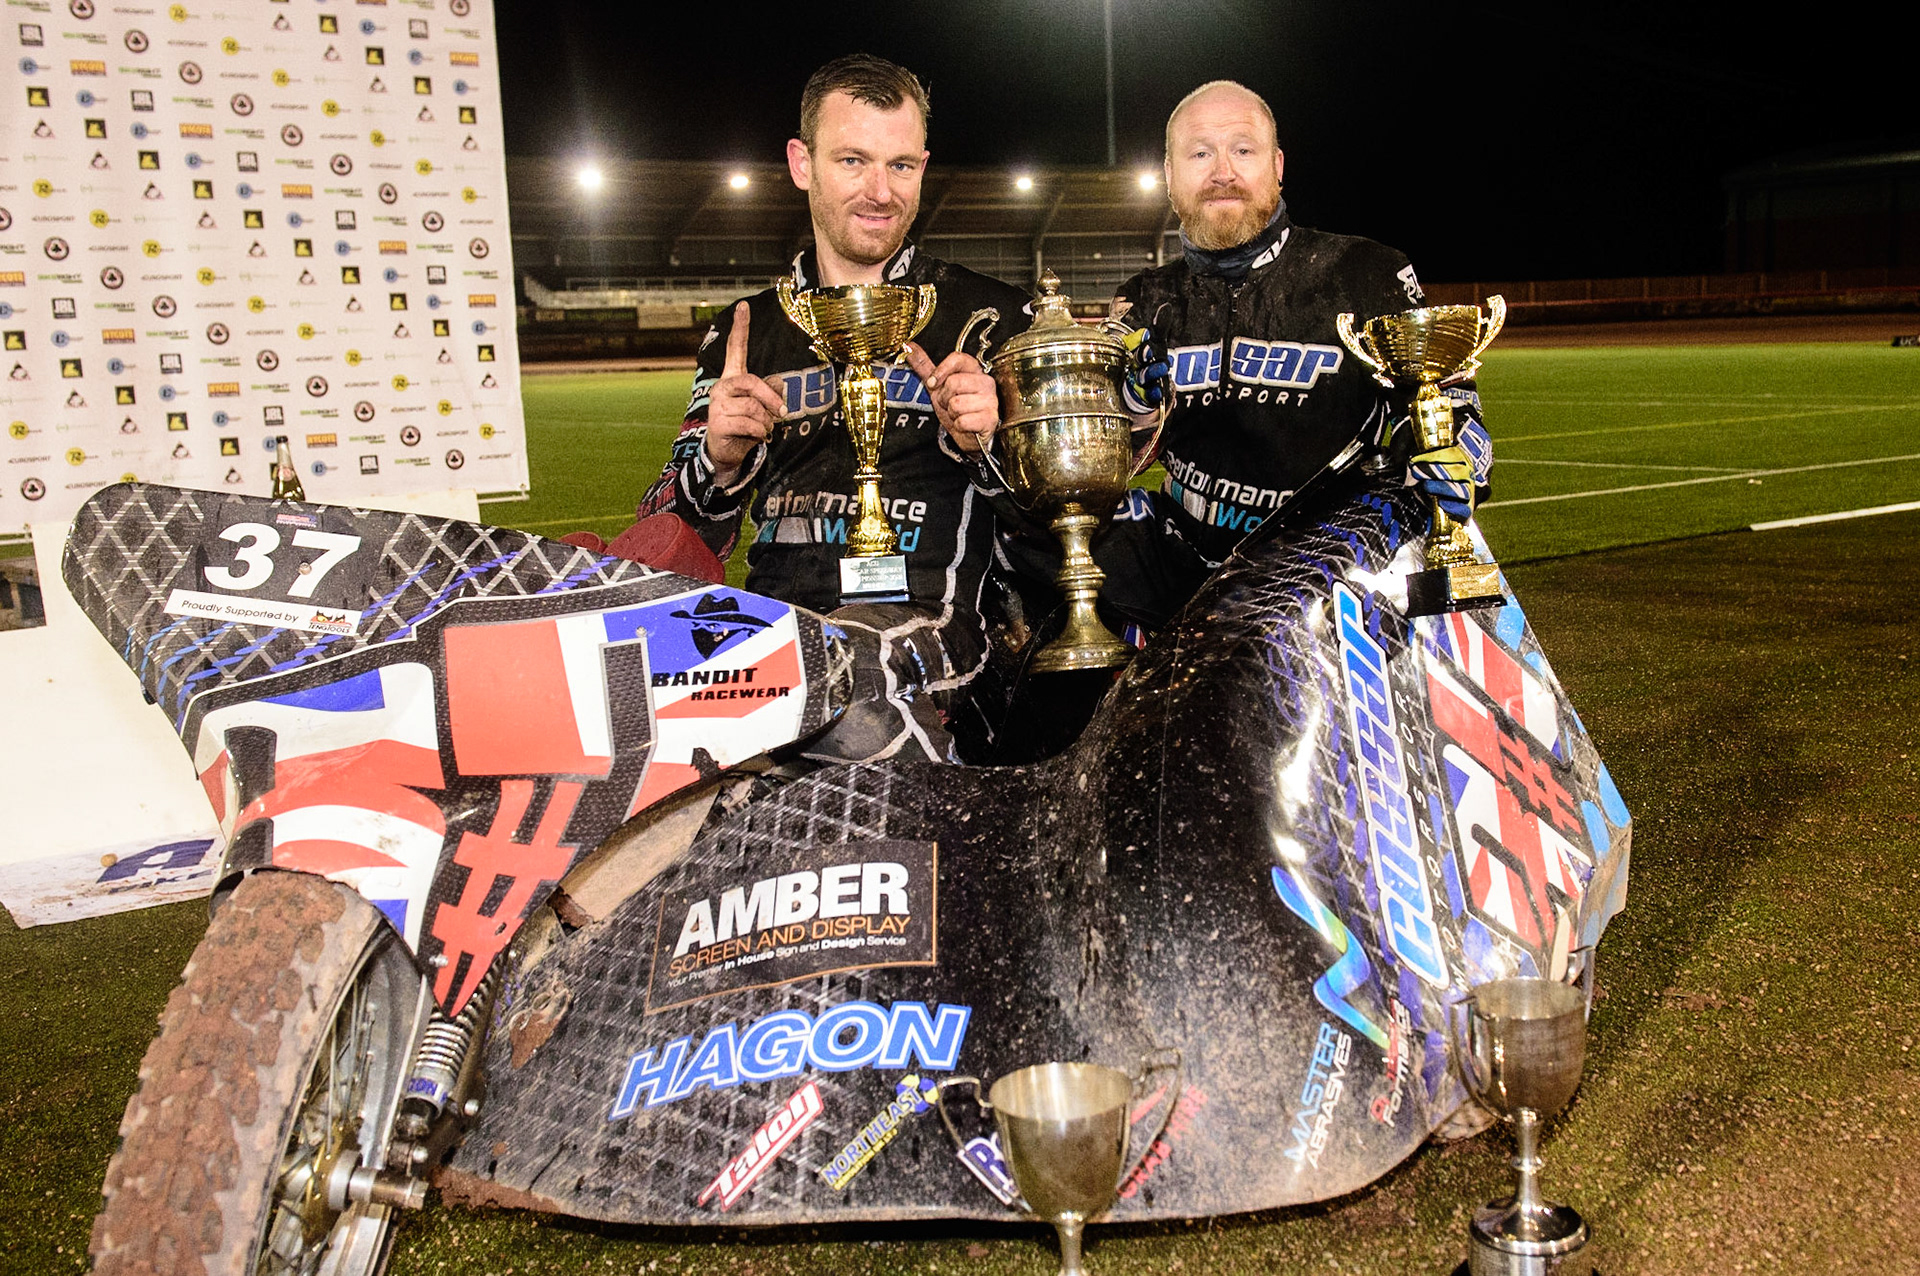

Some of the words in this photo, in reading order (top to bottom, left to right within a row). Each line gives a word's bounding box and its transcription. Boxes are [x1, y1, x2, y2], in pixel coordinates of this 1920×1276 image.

[203, 522, 362, 598] 37
[181, 600, 222, 613] Proudly
[225, 606, 282, 620] Supported
[285, 614, 299, 623] by
[651, 668, 758, 688] BANDIT
[691, 687, 790, 701] RACEWEAR
[668, 936, 751, 978] SCREEN
[756, 923, 806, 950] AND
[811, 915, 911, 940] DISPLAY
[673, 862, 910, 958] AMBER
[724, 960, 735, 971] In
[737, 949, 775, 968] House
[799, 940, 820, 953] and
[820, 937, 865, 949] Design
[866, 935, 907, 947] Service
[609, 1001, 972, 1121] HAGON
[1284, 1021, 1339, 1171] MASTER
[1304, 1031, 1352, 1169] ABRASIVES
[699, 1081, 824, 1211] Talon
[822, 1087, 922, 1185] NORTHEAST
